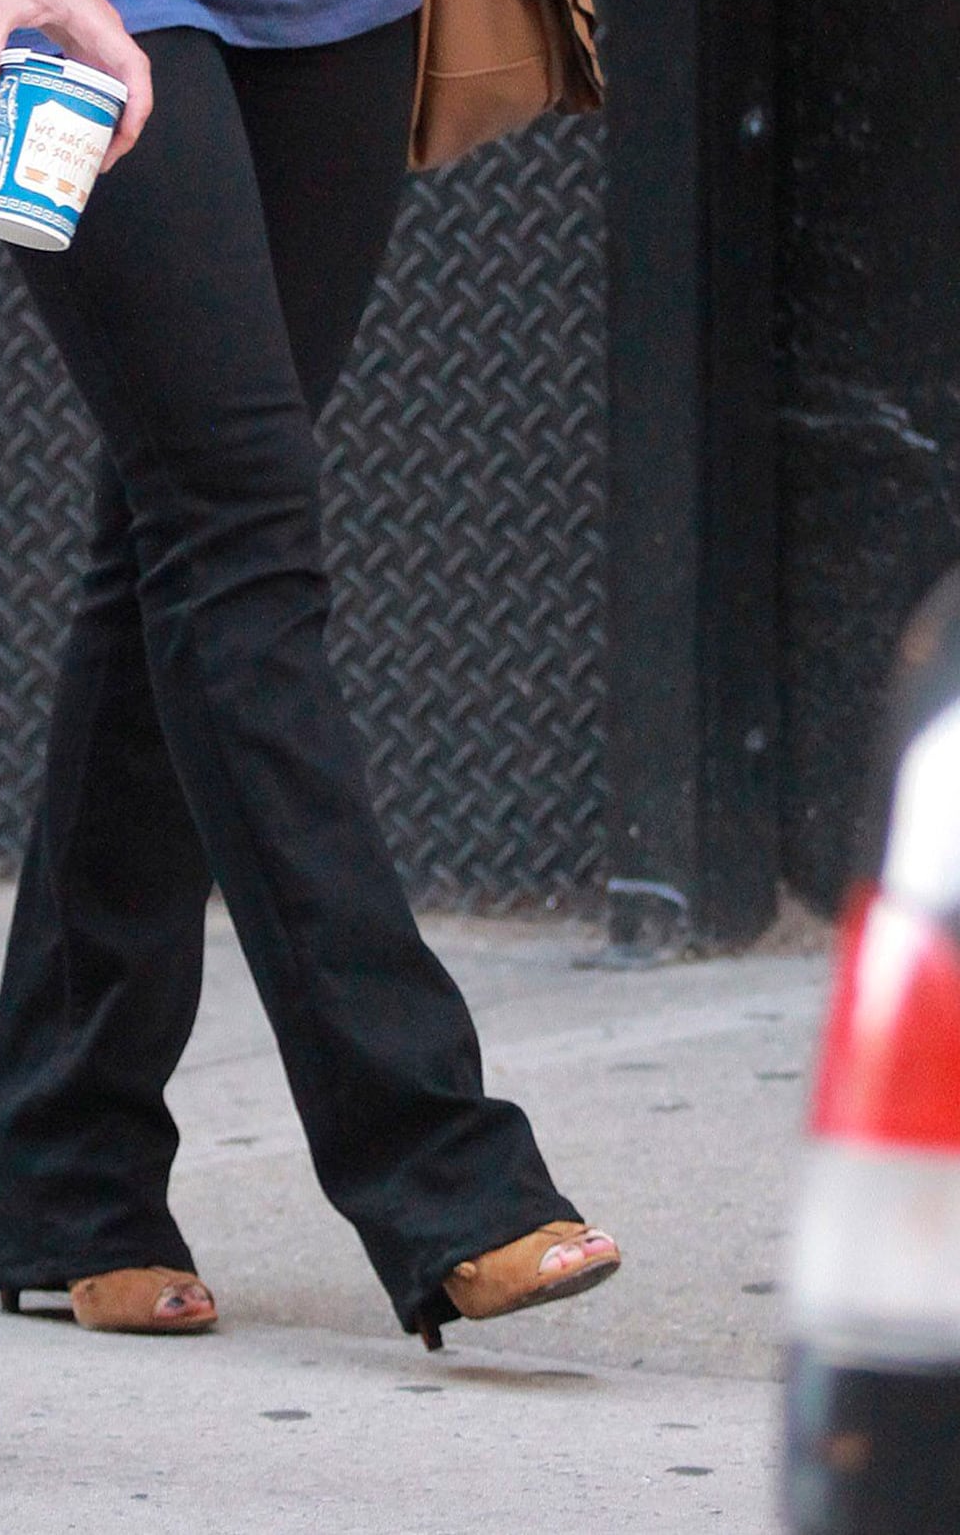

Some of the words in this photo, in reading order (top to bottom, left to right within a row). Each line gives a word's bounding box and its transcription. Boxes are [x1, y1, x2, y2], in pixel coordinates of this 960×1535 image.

[34, 122, 56, 139] WE
[58, 132, 83, 149] ARE
[28, 138, 46, 153] TO
[52, 147, 86, 168] SERVE
